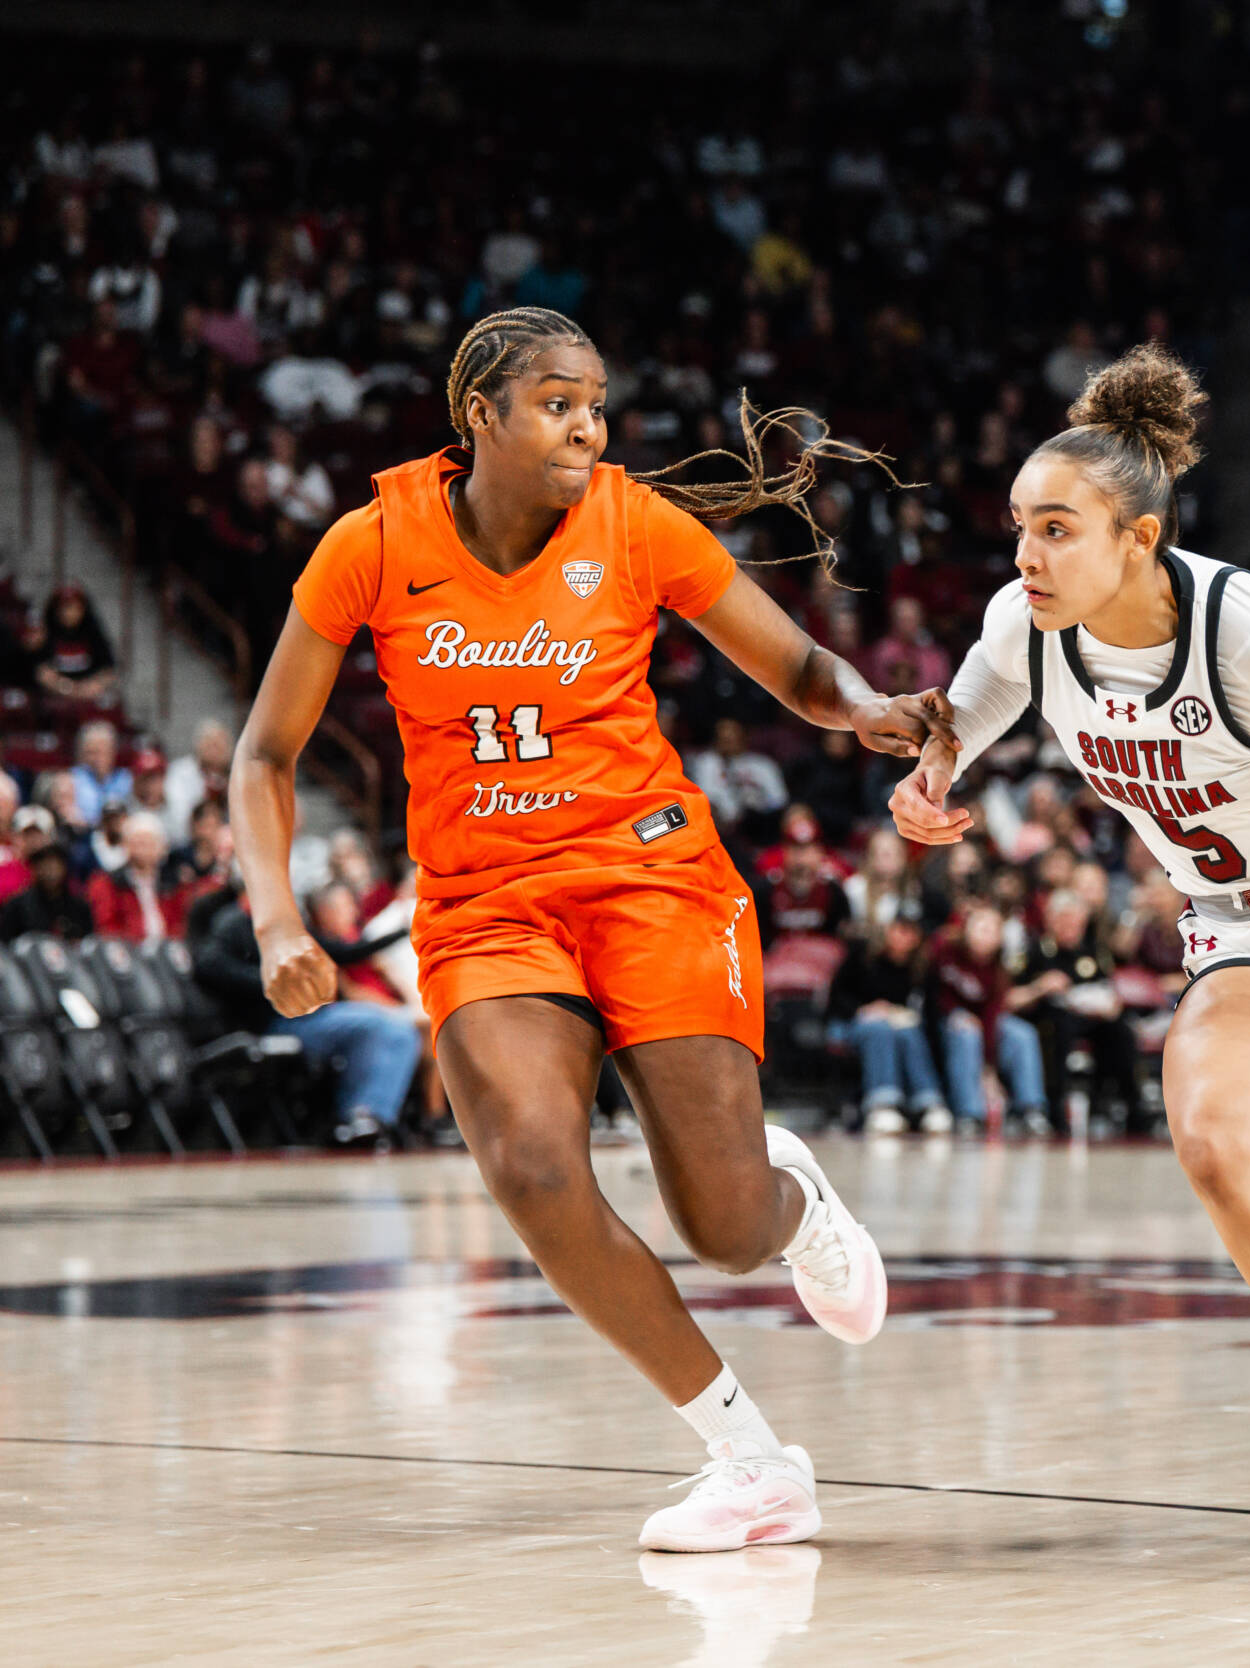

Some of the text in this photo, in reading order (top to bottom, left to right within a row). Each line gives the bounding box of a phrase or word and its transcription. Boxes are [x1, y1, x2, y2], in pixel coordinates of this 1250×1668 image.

[567, 572, 600, 583] MAC
[417, 619, 598, 686] Bowling
[465, 704, 553, 764] 11
[1174, 699, 1209, 735] SEC
[1077, 731, 1186, 781] SOUTH
[464, 781, 580, 817] Green
[669, 812, 681, 823] L
[1086, 772, 1238, 818] AROLINA
[1151, 813, 1247, 884] 5
